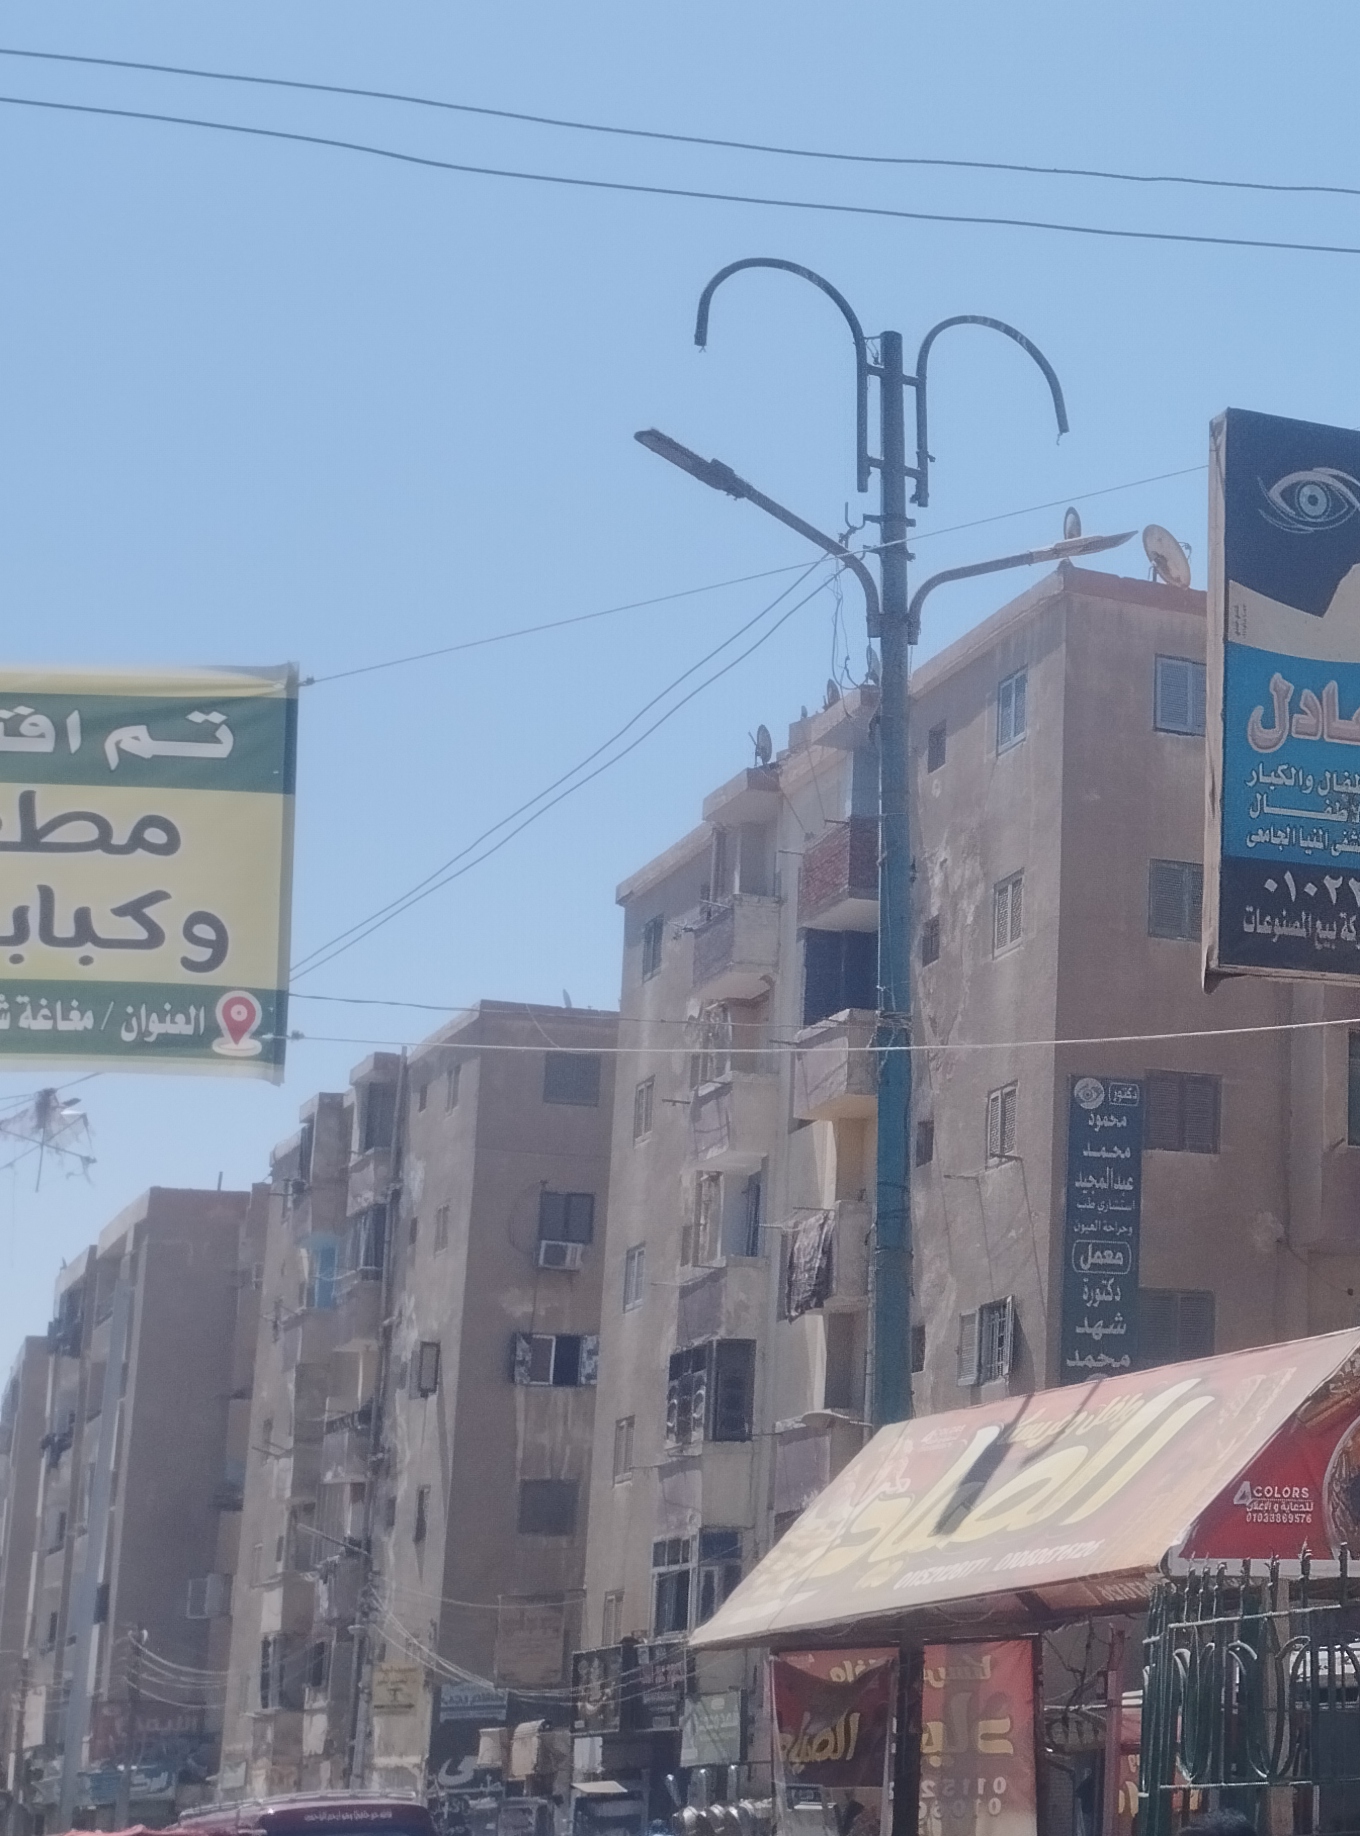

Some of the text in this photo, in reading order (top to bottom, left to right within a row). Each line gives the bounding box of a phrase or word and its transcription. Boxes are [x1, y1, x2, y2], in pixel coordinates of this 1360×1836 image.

[104, 709, 234, 772] تم
[1245, 762, 1314, 794] والكبار
[1300, 826, 1329, 855] المنيا
[1314, 920, 1337, 950] بيع
[18, 994, 95, 1031] مغاغة
[119, 1001, 205, 1043] العنوان
[1112, 1083, 1138, 1103] دكتور
[1088, 1111, 1127, 1132] محمود
[1082, 1142, 1131, 1158] محمد
[1080, 1243, 1125, 1270] معمل
[1082, 1277, 1121, 1307] دكتورة
[1075, 1311, 1127, 1340] شهد
[1066, 1349, 1132, 1369] محمد
[806, 1378, 1216, 1589] الصياد
[1253, 1486, 1310, 1498] COLORS
